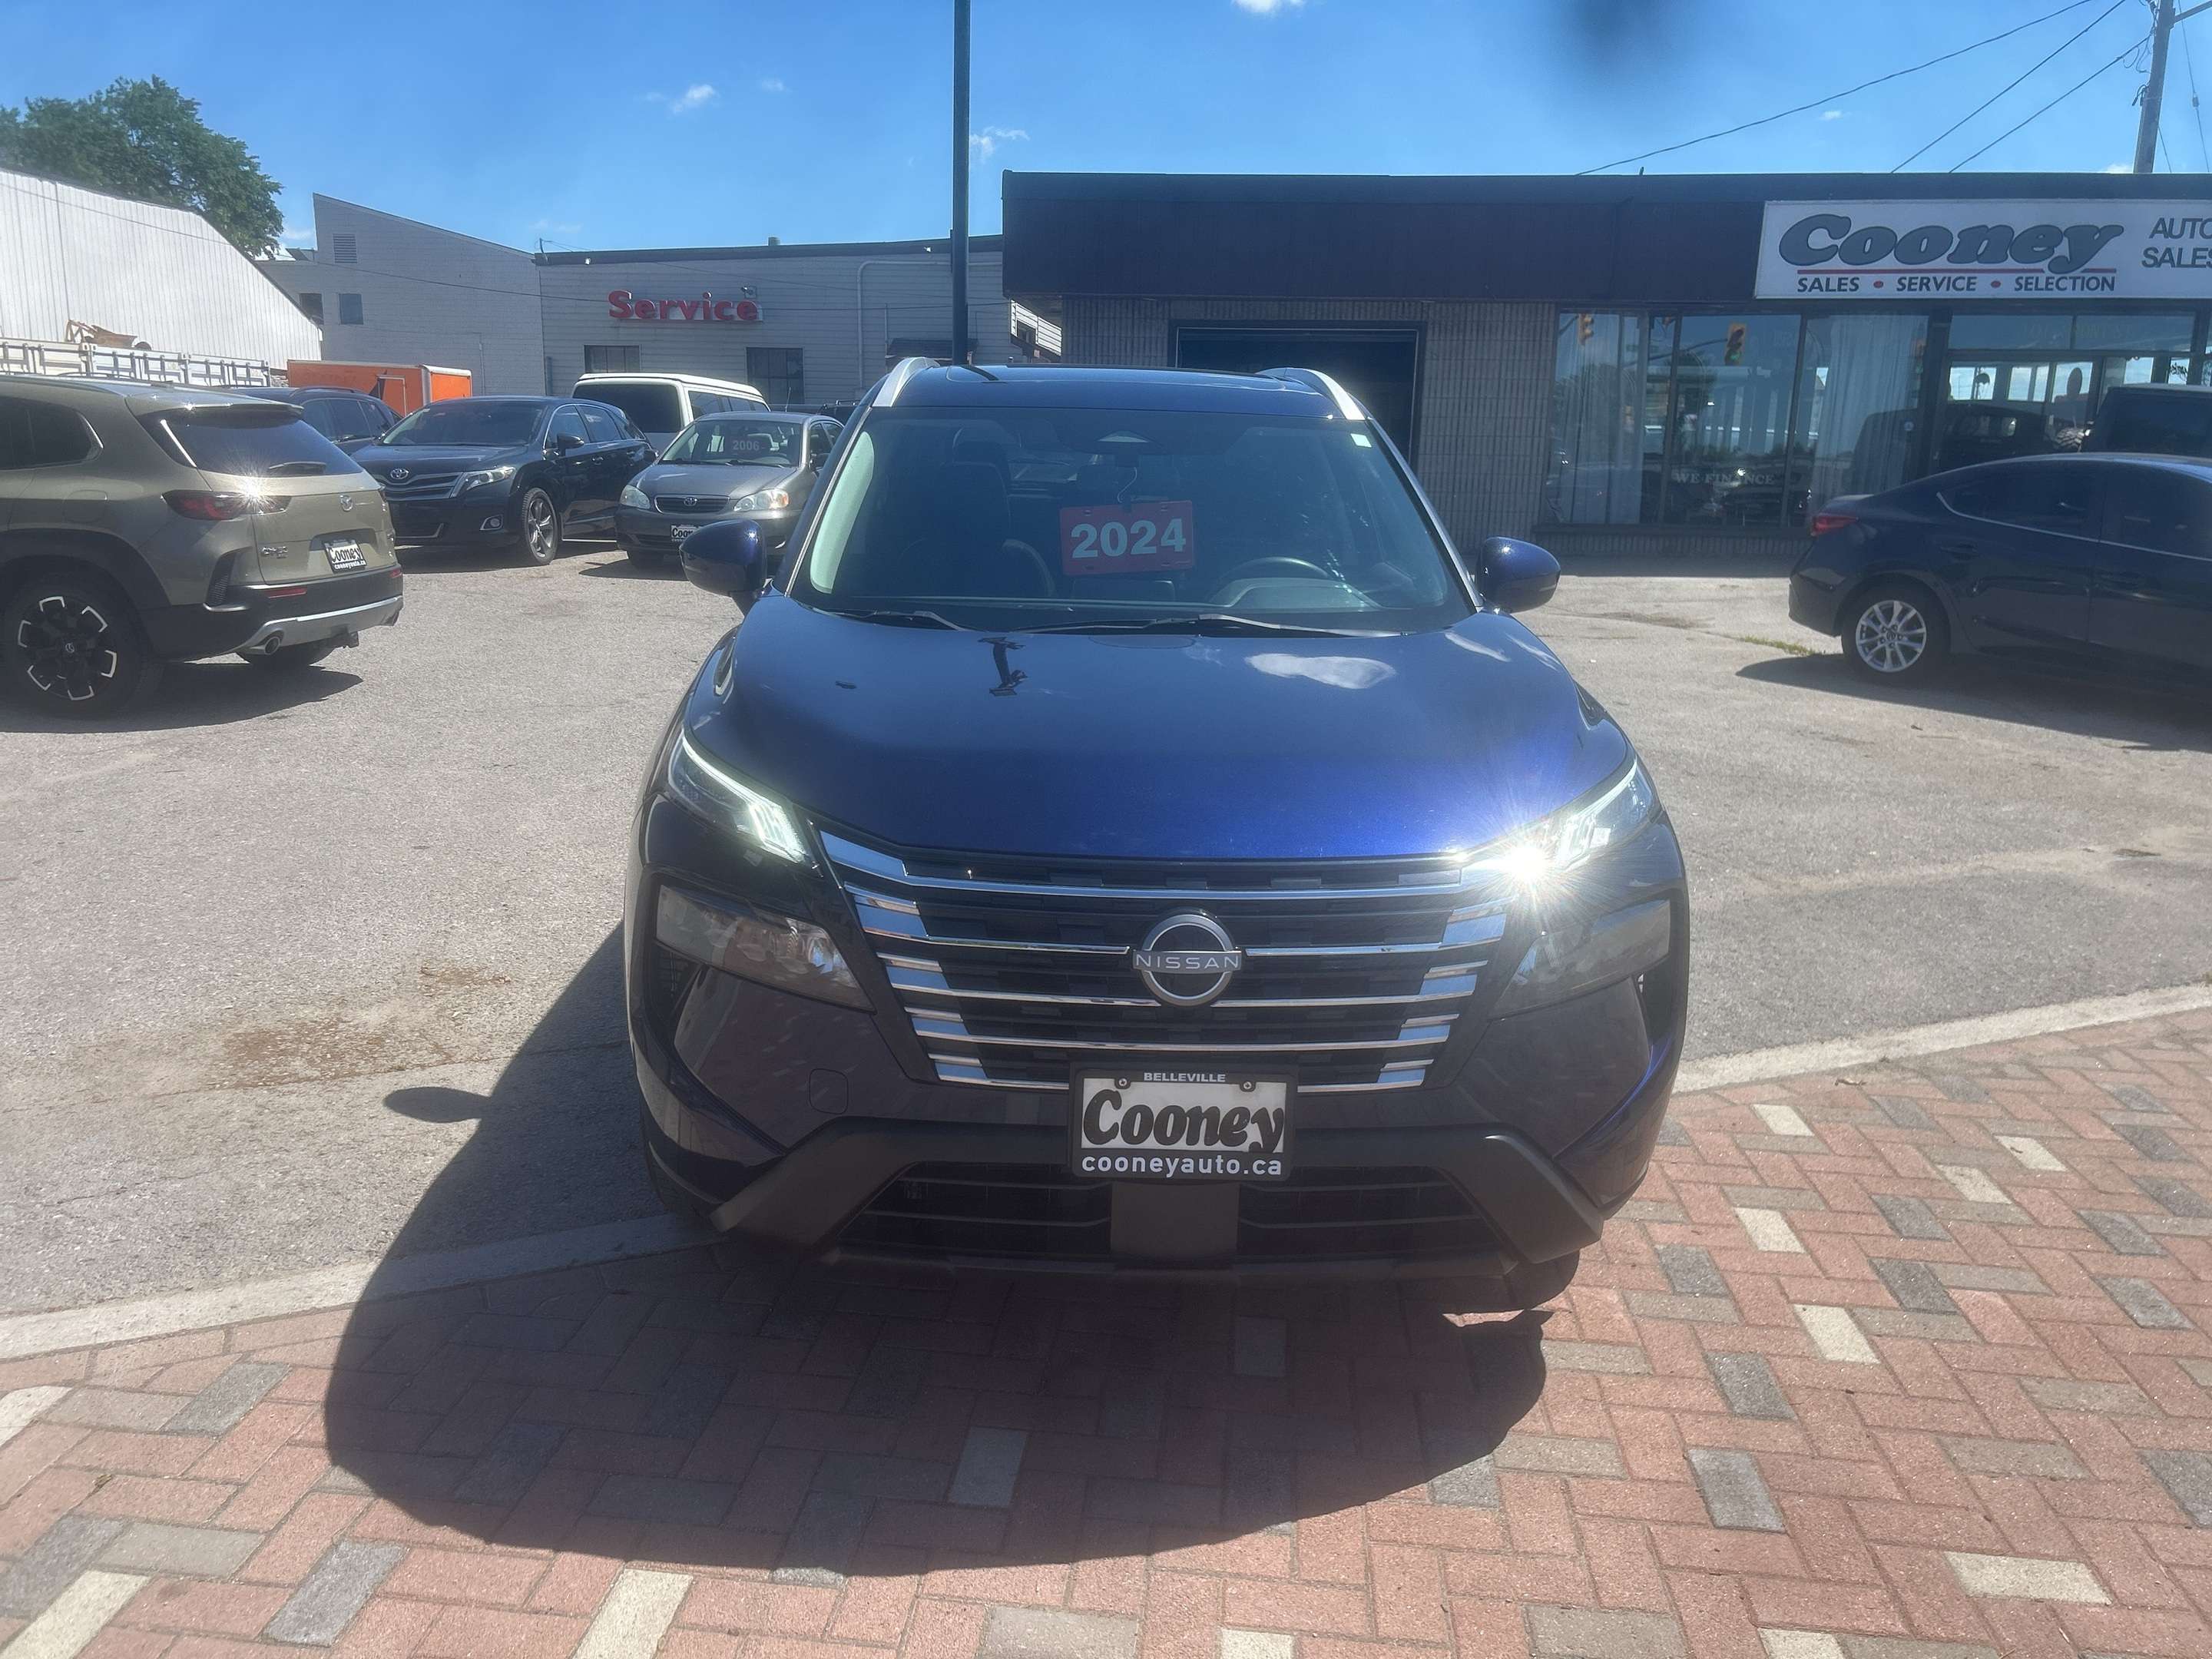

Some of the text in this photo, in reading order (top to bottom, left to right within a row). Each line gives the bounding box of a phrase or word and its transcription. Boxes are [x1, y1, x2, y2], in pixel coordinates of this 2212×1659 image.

[1779, 214, 2124, 274] Cooney
[1797, 276, 2115, 293] SALES SERVICE SELECTION
[608, 290, 758, 320] Service
[732, 440, 760, 451] 2006
[1071, 510, 1187, 558] 2024
[329, 547, 364, 562] Cooney
[1136, 953, 1239, 969] NISSAN
[1144, 1072, 1226, 1082] BELLEVILLE
[1083, 1088, 1284, 1153] Cooney
[1081, 1154, 1282, 1177] cooneyauto.ca
